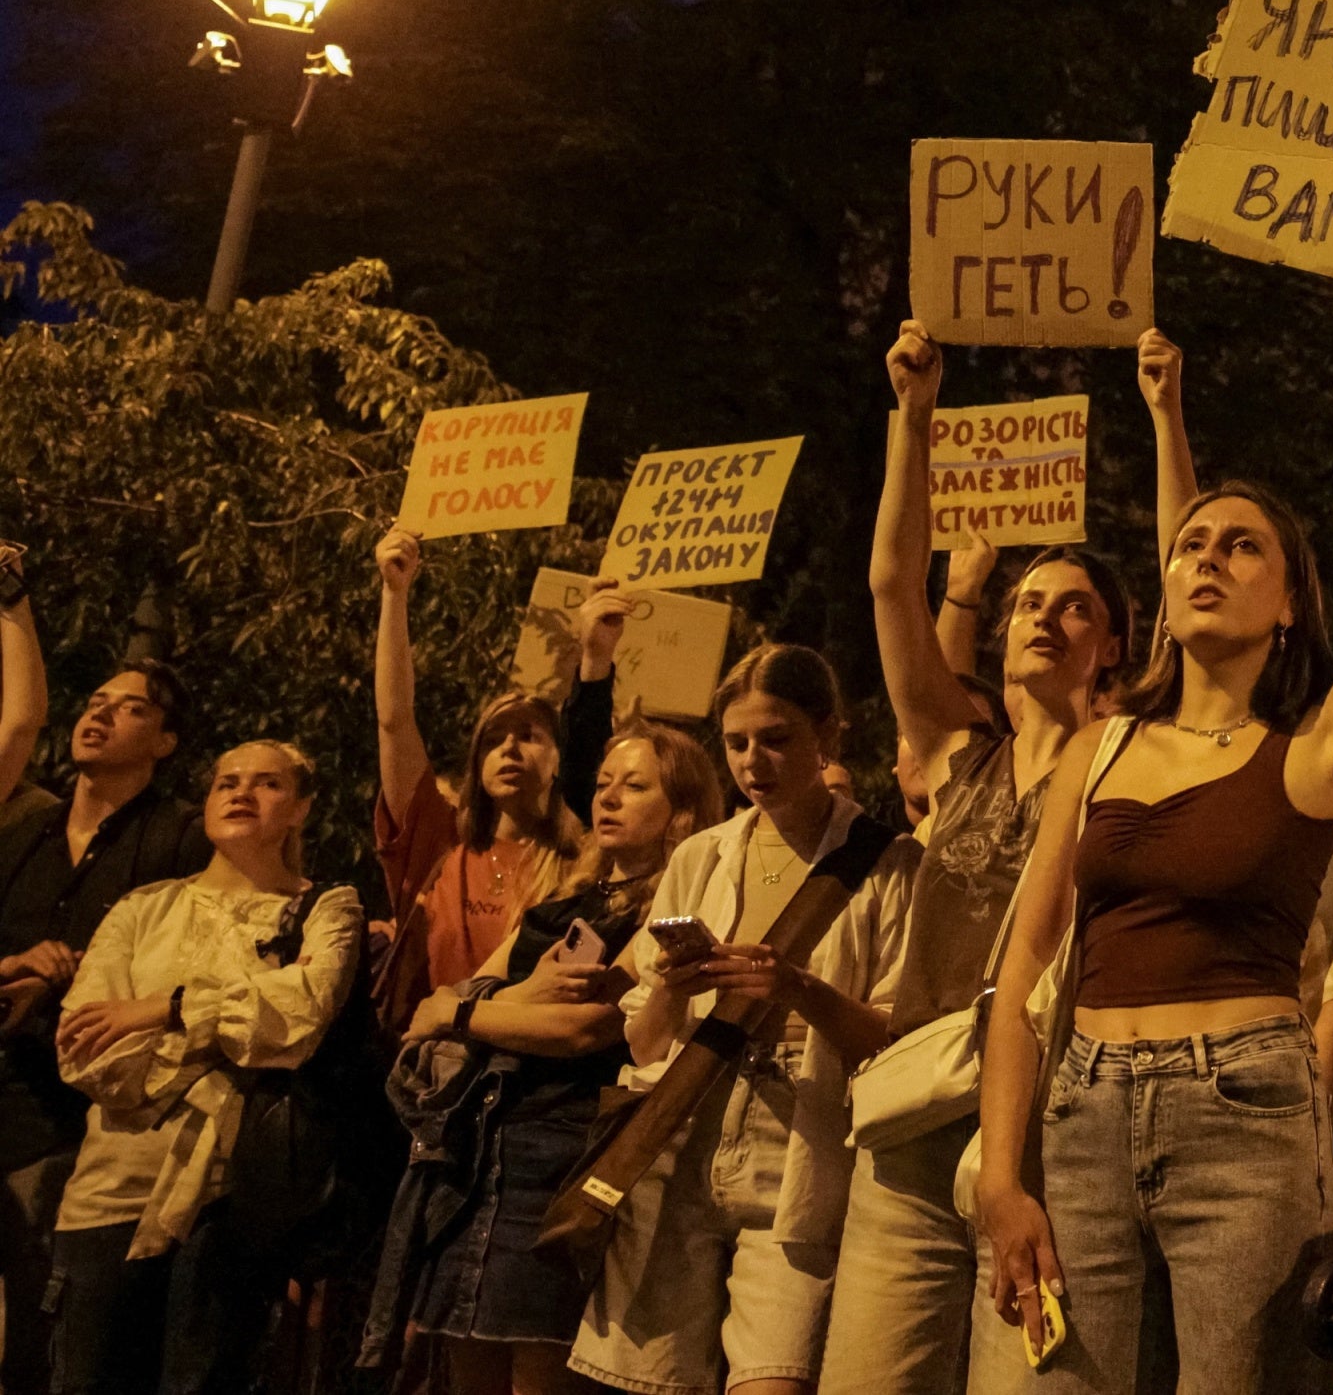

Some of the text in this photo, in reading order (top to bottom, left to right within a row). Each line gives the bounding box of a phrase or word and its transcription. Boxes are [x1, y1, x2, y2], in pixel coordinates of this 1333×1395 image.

[926, 155, 1102, 238] РУКИ
[421, 407, 574, 446] КОРУПЦІЯ
[931, 411, 1086, 448] РОЗОРІСТЬ
[429, 440, 546, 478] НЕ МАЄ
[929, 456, 1086, 495] ЗАЛЕЖНІСТЬ
[427, 478, 556, 519] ГОЛОСУ
[931, 491, 1076, 534] СТИТУЦІЙ
[615, 509, 774, 547] ОКУПАЦІЯ
[627, 542, 760, 581] ЗАКОНУ
